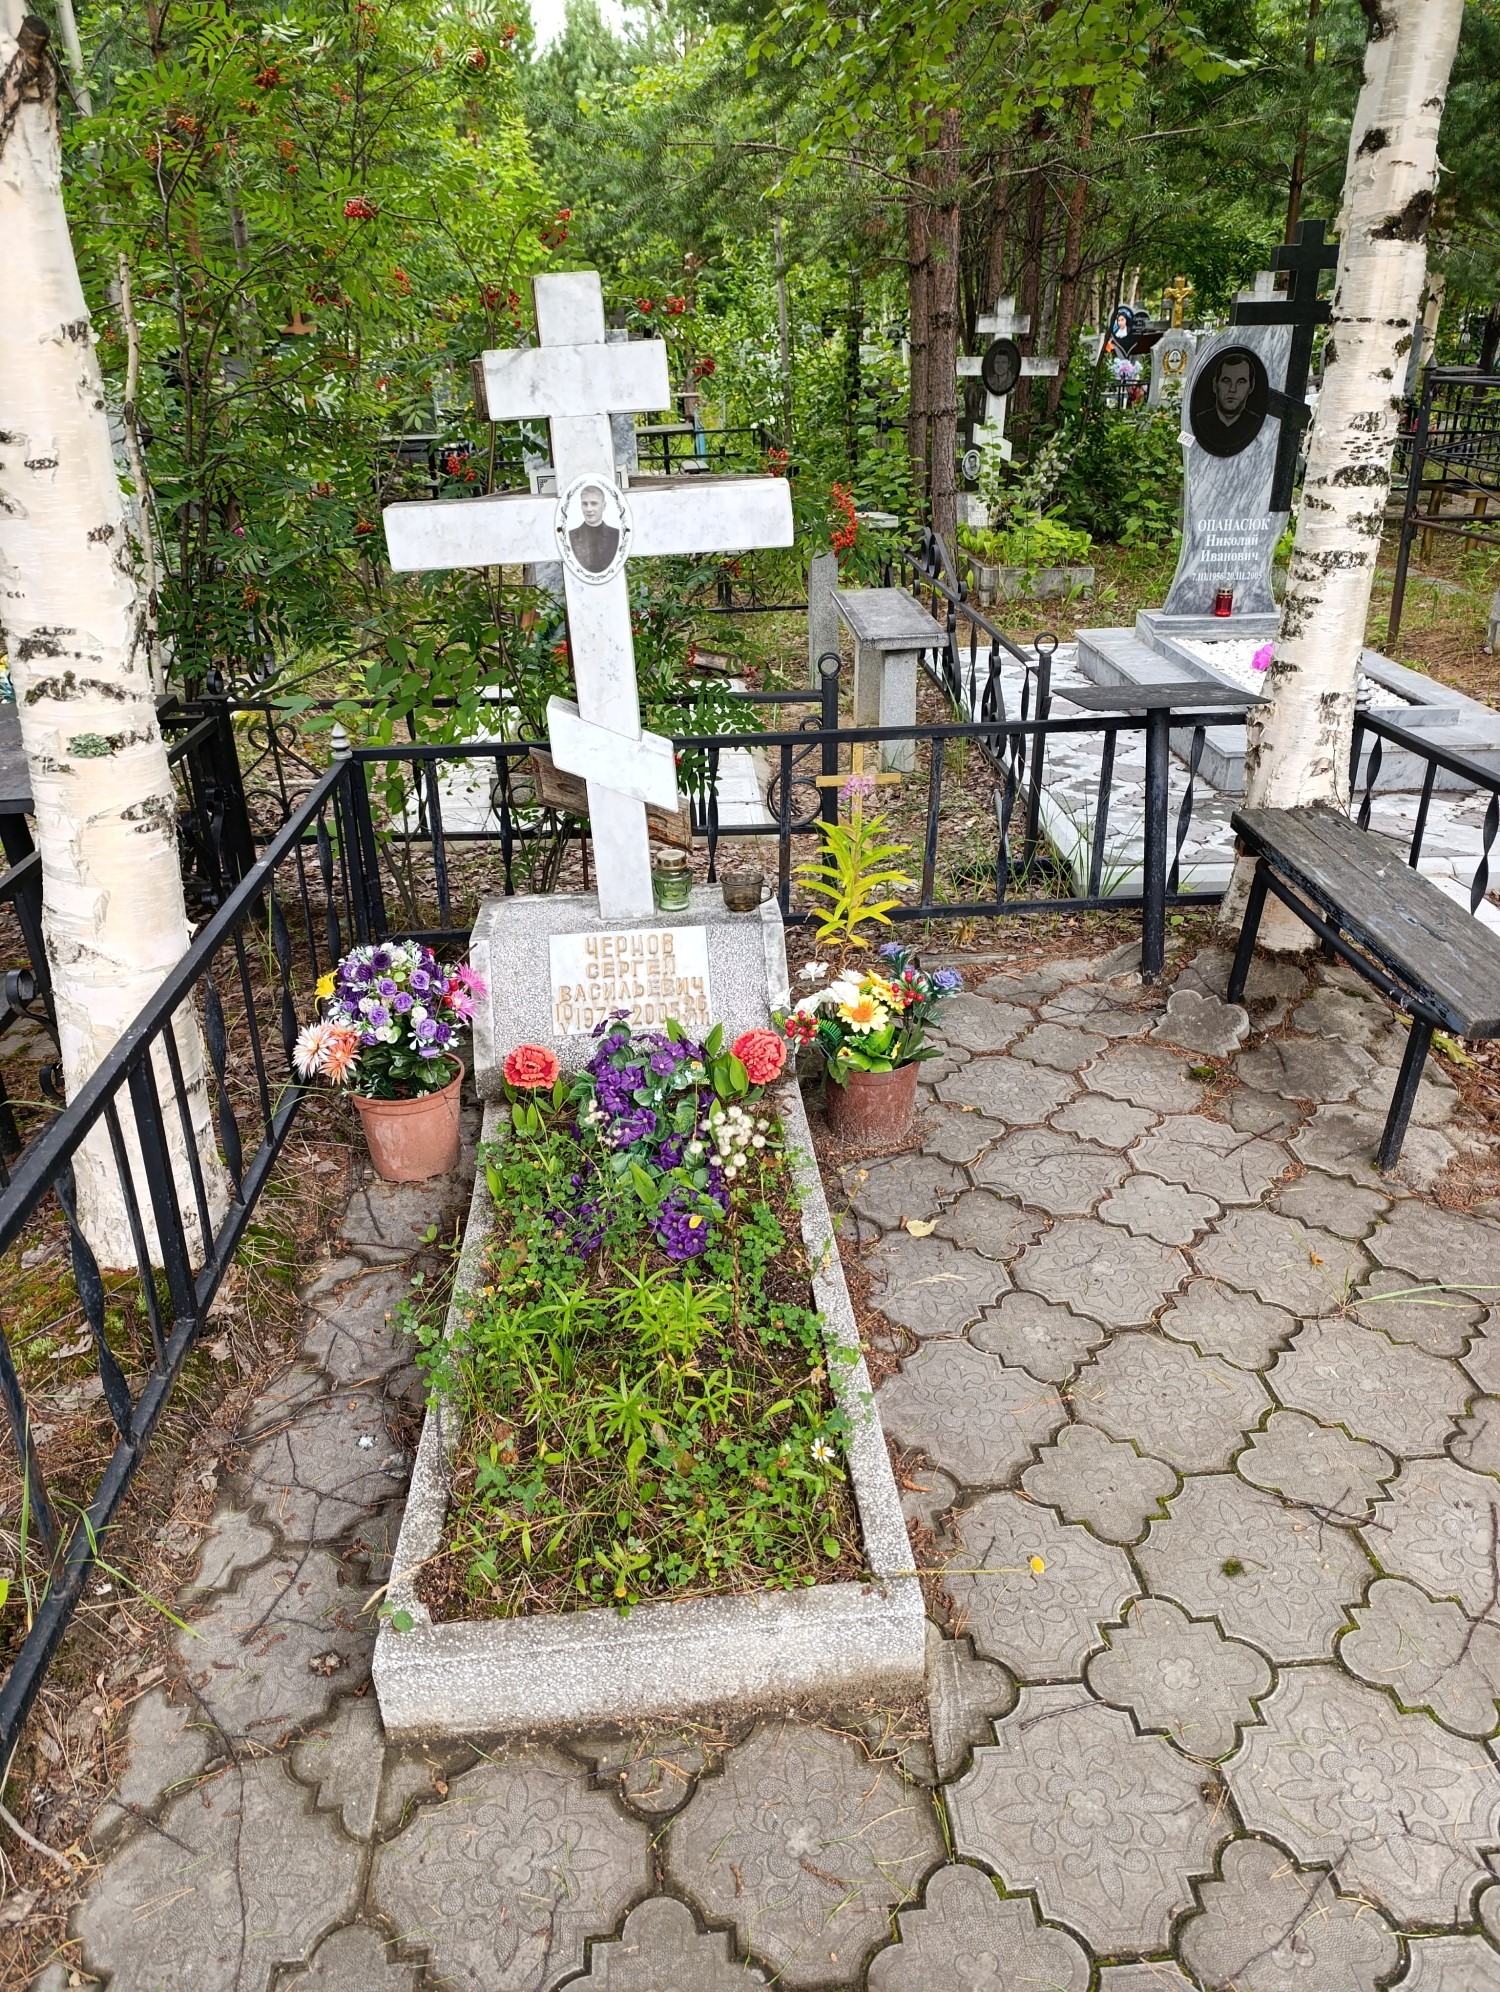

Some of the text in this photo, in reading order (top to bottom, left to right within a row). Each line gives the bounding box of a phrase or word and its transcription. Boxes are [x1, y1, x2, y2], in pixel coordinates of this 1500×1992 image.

[1197, 518, 1271, 532] ОПАНАСЮК
[1205, 533, 1260, 547] Николай
[1200, 550, 1259, 562] Иванович
[584, 932, 674, 958] ЧЕРНОВ
[585, 954, 676, 979] СЕРГЕЙ
[558, 976, 704, 1003] ВАСИЛЬЕВИЧ
[631, 1001, 680, 1026] 2005
